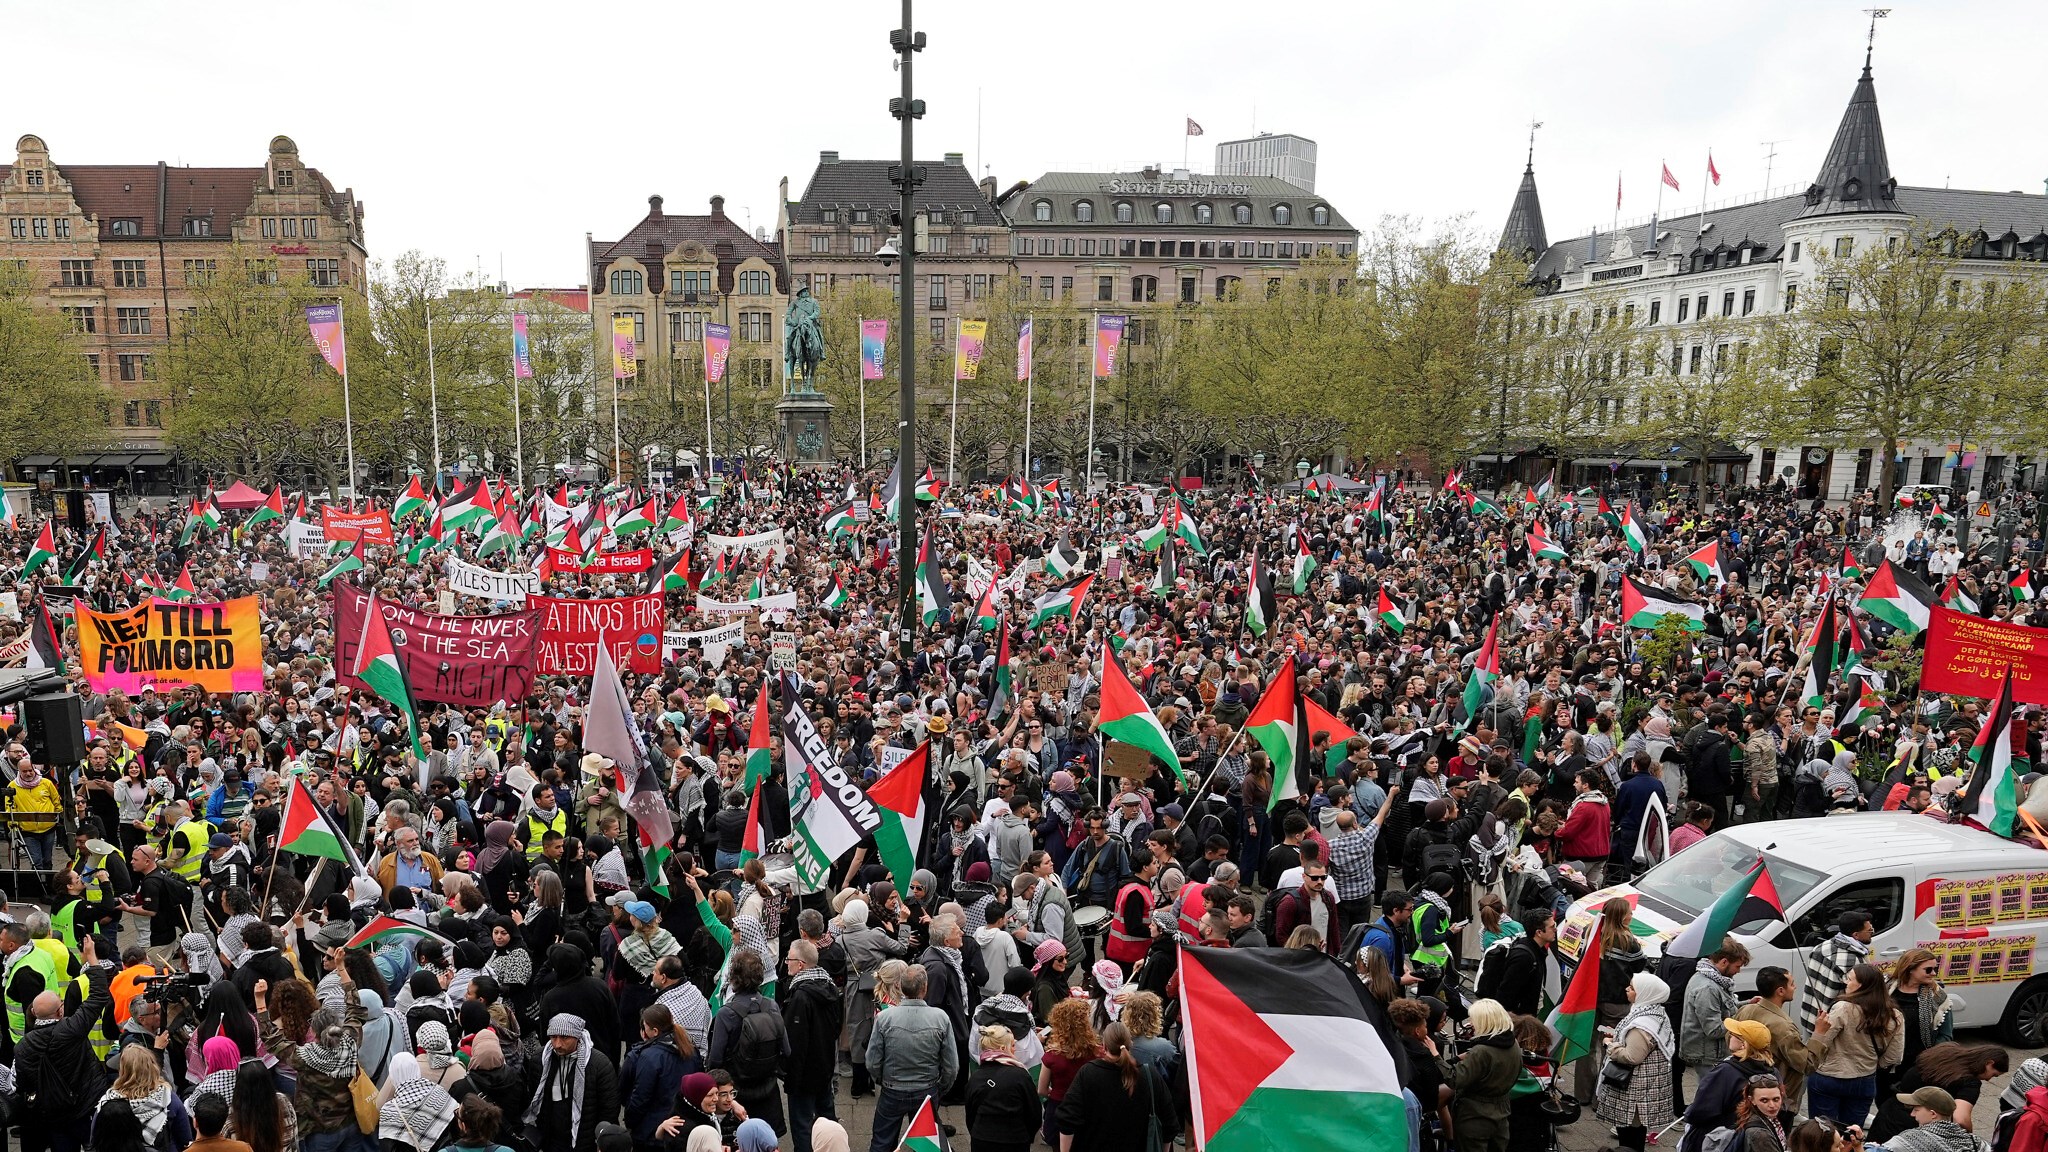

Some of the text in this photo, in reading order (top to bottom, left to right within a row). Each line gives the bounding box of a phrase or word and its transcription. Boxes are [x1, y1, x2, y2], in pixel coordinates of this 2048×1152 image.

[1109, 179, 1250, 197] Stena Fastigheter
[1594, 271, 1615, 281] HOTEL
[626, 336, 634, 363] MUSIC
[1107, 344, 1115, 374] UNITED
[711, 352, 721, 380] UNITED
[558, 553, 641, 568] Bojktta Israel
[450, 566, 539, 595] PALESTINE
[90, 604, 232, 645] NEJ TILL
[355, 594, 415, 626] FOM
[470, 618, 529, 638] RIVER
[633, 598, 662, 631] FOR
[1947, 617, 1966, 627] LEVE
[1967, 621, 1986, 630] DEN
[418, 632, 460, 655] THE
[466, 639, 510, 662] SEA
[663, 635, 686, 647] DENTS
[704, 627, 742, 645] PALESTINE
[98, 639, 234, 673] FOLKMORD
[536, 640, 631, 672] PALESTE
[1961, 646, 1977, 655] DET
[1978, 648, 1989, 656] ER
[1966, 655, 1993, 665] GØRE
[1994, 658, 2028, 670] OPØR!
[435, 661, 529, 702] RIGHTS
[784, 701, 881, 832] FREEDOM
[1972, 901, 1991, 909] AGAINST
[2002, 903, 2020, 911] GENOCIDE
[2032, 894, 2048, 902] AGAINS
[2032, 902, 2048, 910] GENOCID
[1972, 909, 1991, 917] GENOCIDE
